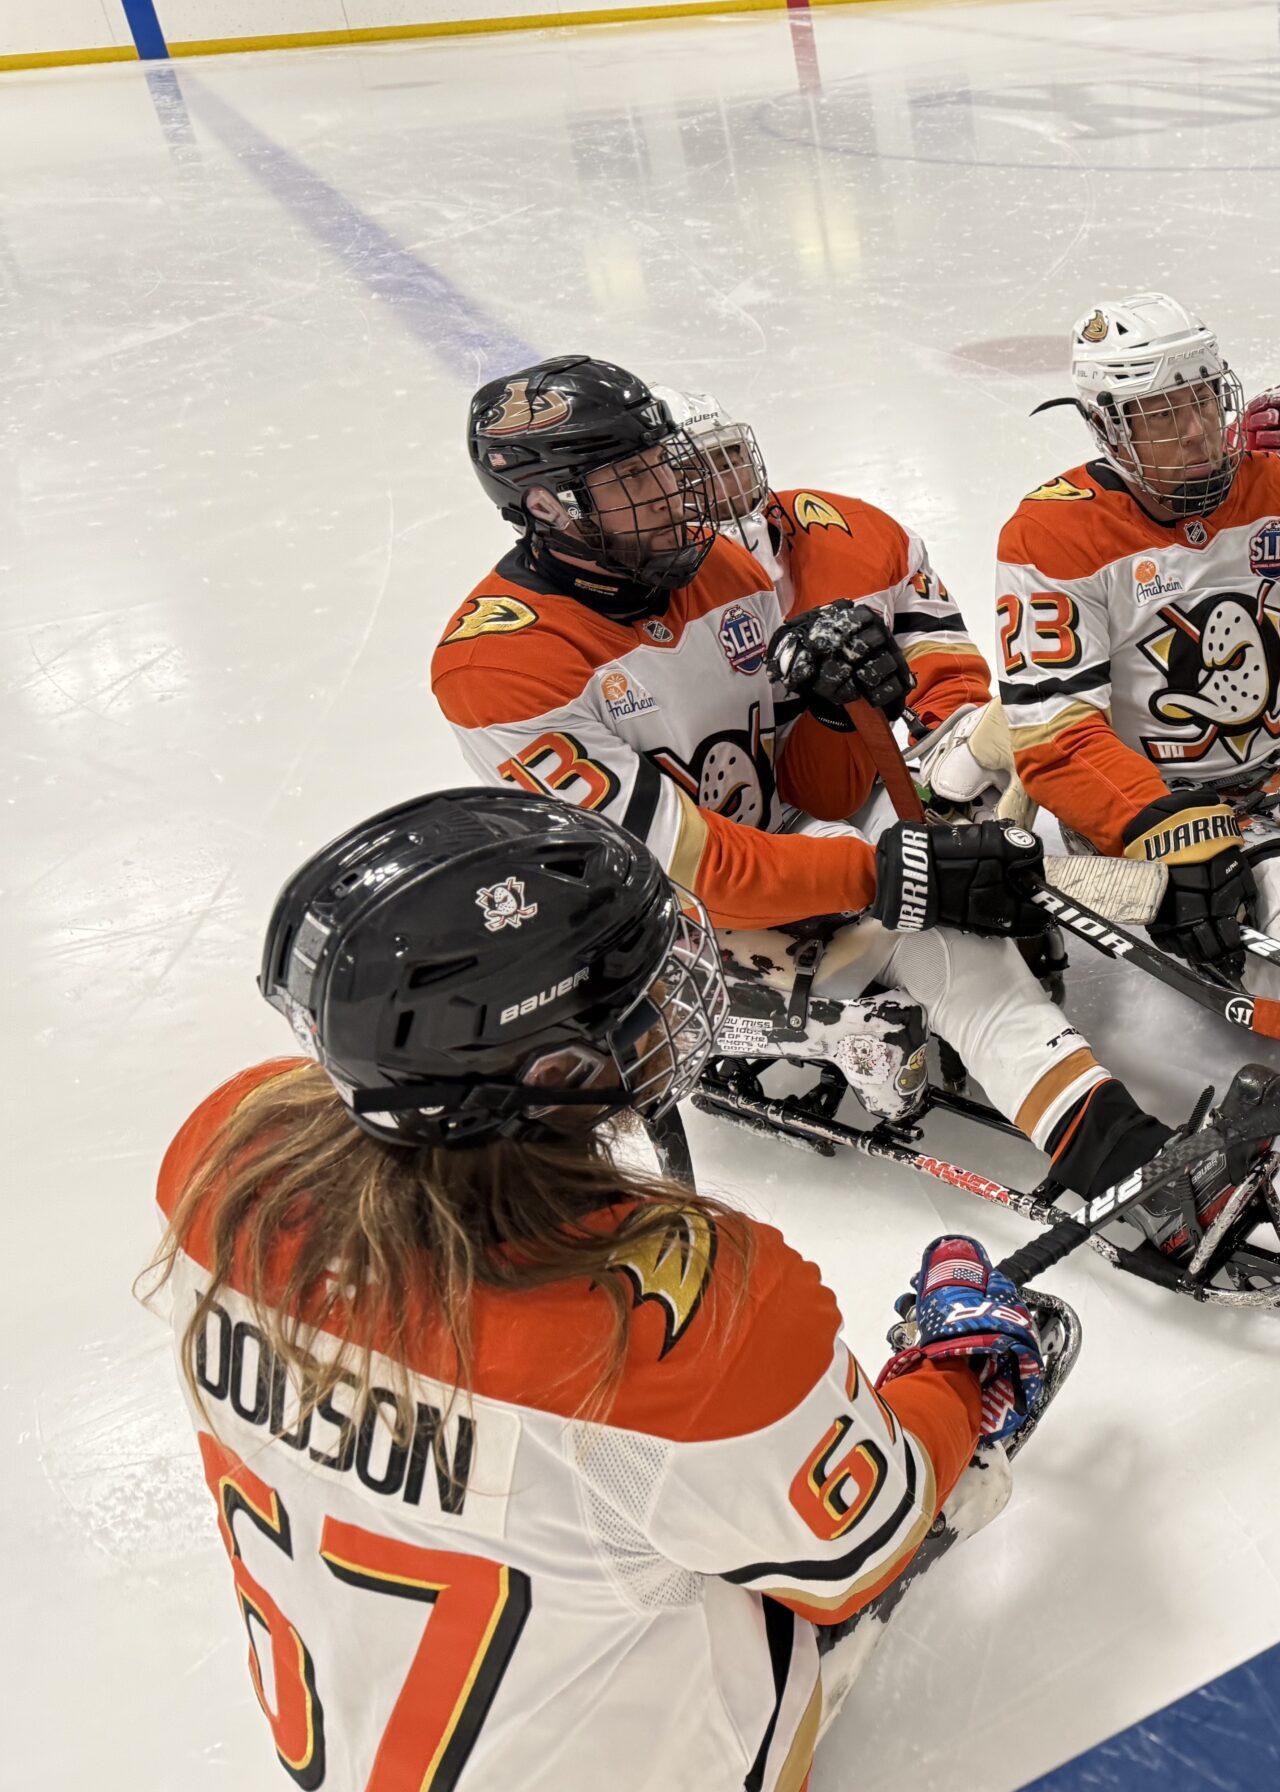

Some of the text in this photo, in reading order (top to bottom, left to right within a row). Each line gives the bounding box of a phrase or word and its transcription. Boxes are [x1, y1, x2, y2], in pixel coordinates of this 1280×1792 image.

[679, 411, 720, 428] AUER
[1137, 574, 1183, 603] Anaheim
[719, 617, 764, 659] SLED
[997, 592, 1083, 676] 23
[1143, 814, 1242, 861] WARRIO
[897, 828, 929, 934] ARRIOR
[1031, 890, 1134, 957] RIOR
[500, 966, 589, 1026] BAUER
[741, 1019, 772, 1029] MISS
[194, 1288, 477, 1516] DODSON
[198, 1430, 533, 1792] 67
